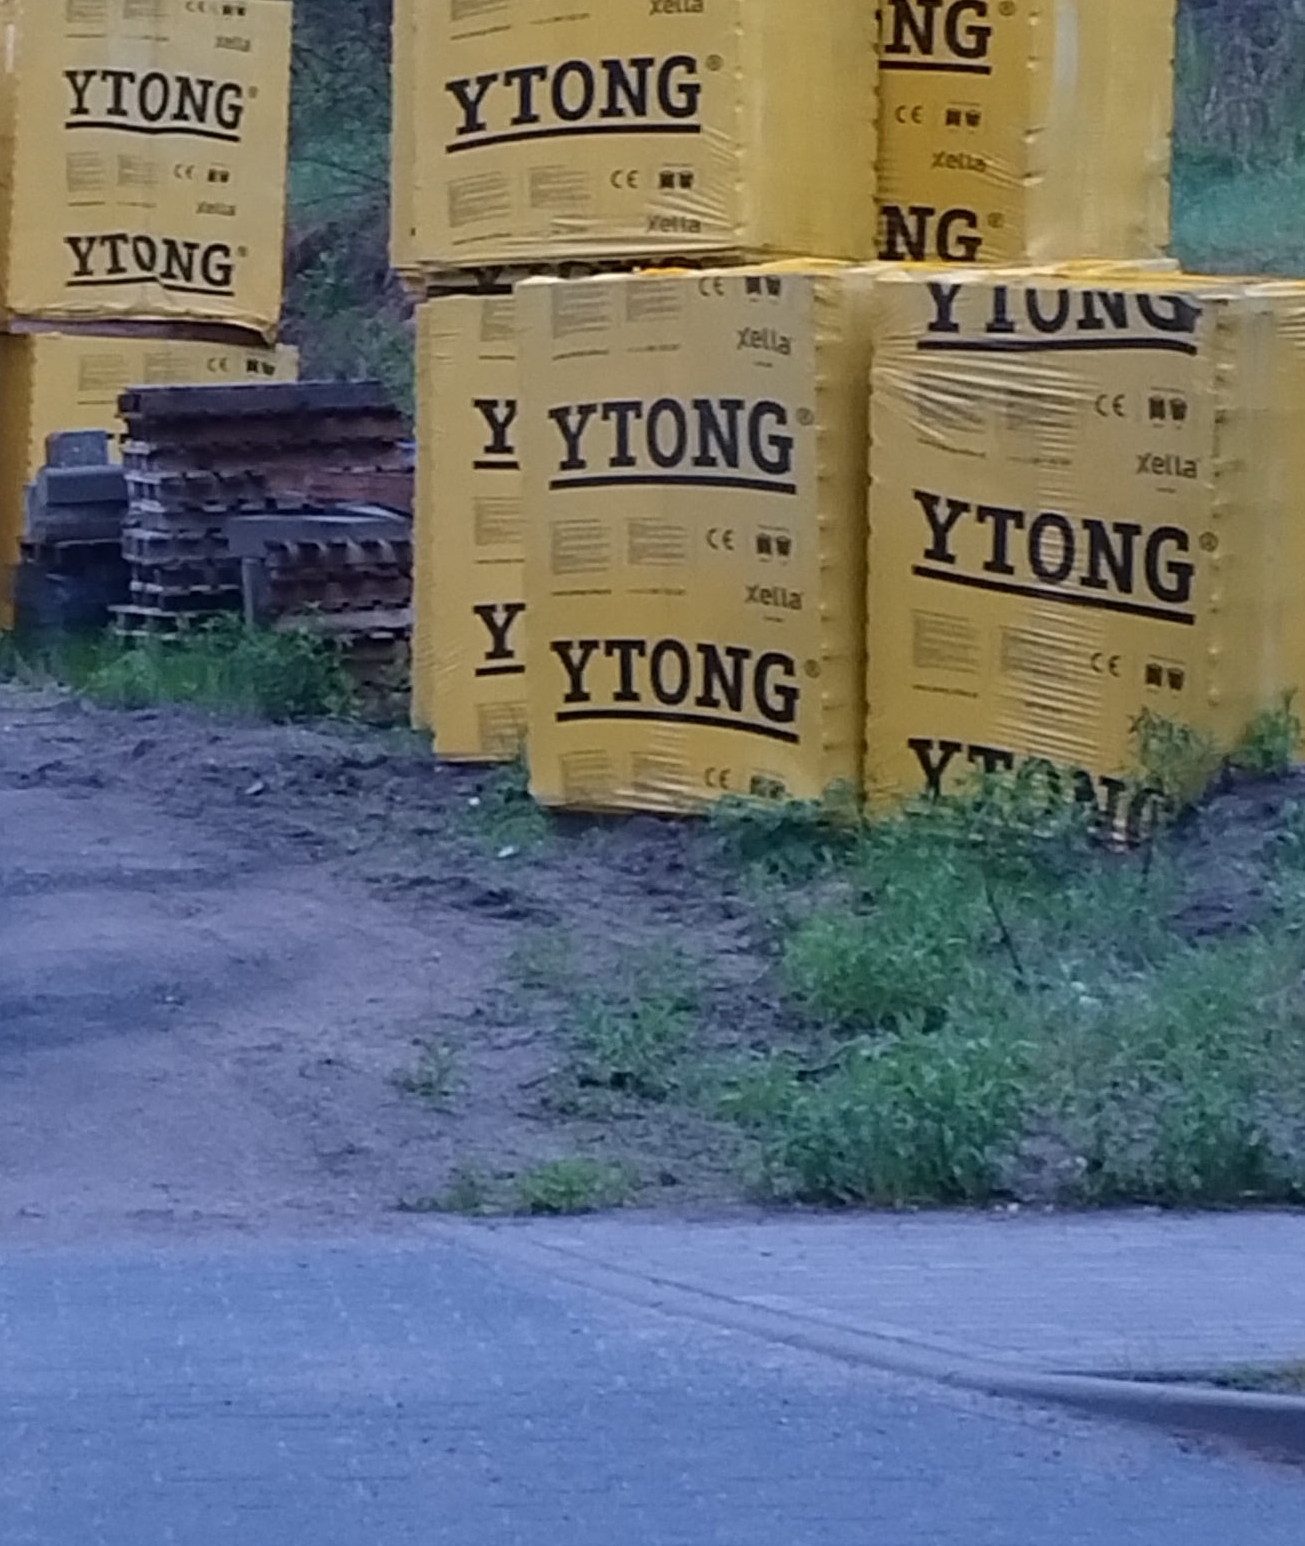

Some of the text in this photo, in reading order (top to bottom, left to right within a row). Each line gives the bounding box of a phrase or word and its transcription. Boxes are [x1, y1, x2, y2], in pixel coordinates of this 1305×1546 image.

[65, 70, 243, 129] YTONG
[445, 56, 701, 135] YTONG
[65, 234, 235, 287] YTONG
[549, 399, 793, 475] YTONG
[914, 490, 1194, 603] YTONG
[550, 639, 799, 723] YTONG
